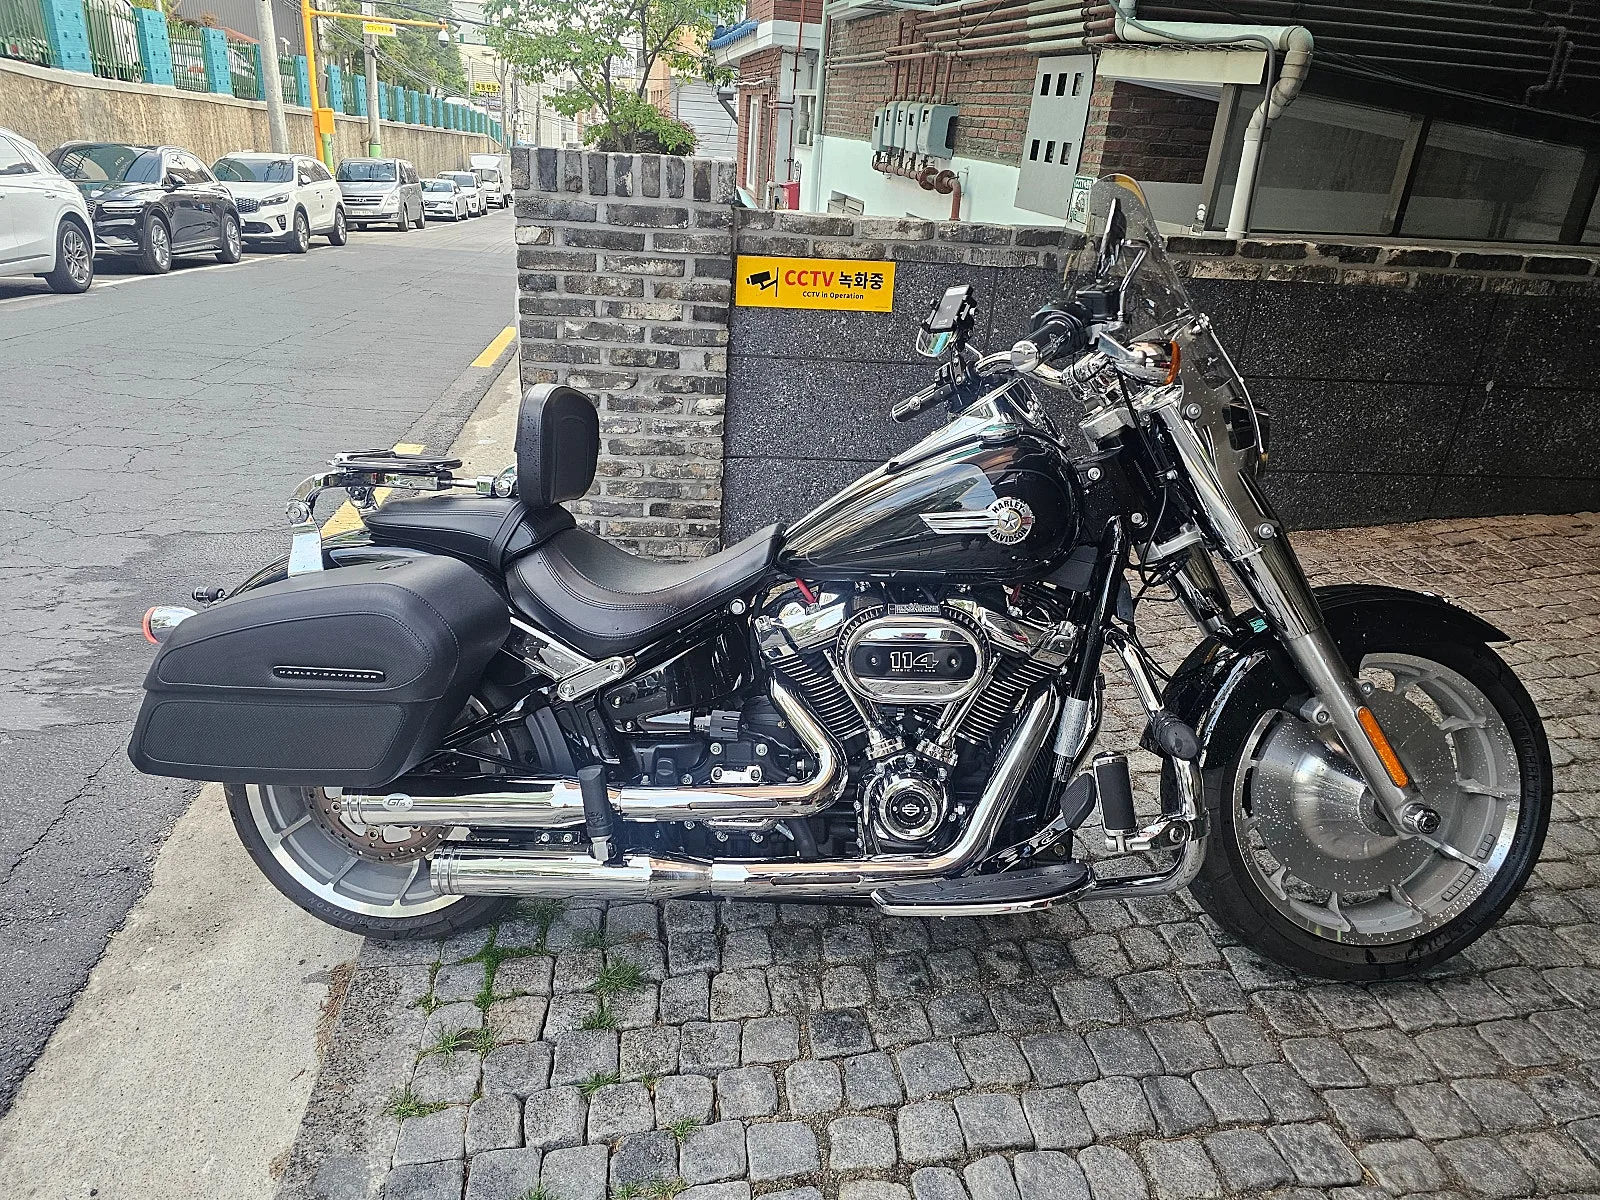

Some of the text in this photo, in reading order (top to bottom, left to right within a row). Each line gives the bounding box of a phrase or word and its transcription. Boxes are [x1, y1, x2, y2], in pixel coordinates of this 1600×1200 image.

[784, 269, 884, 290] CCTV 녹화중
[829, 291, 864, 300] Operation
[990, 526, 1029, 543] DAVIDSON
[890, 651, 940, 669] 114
